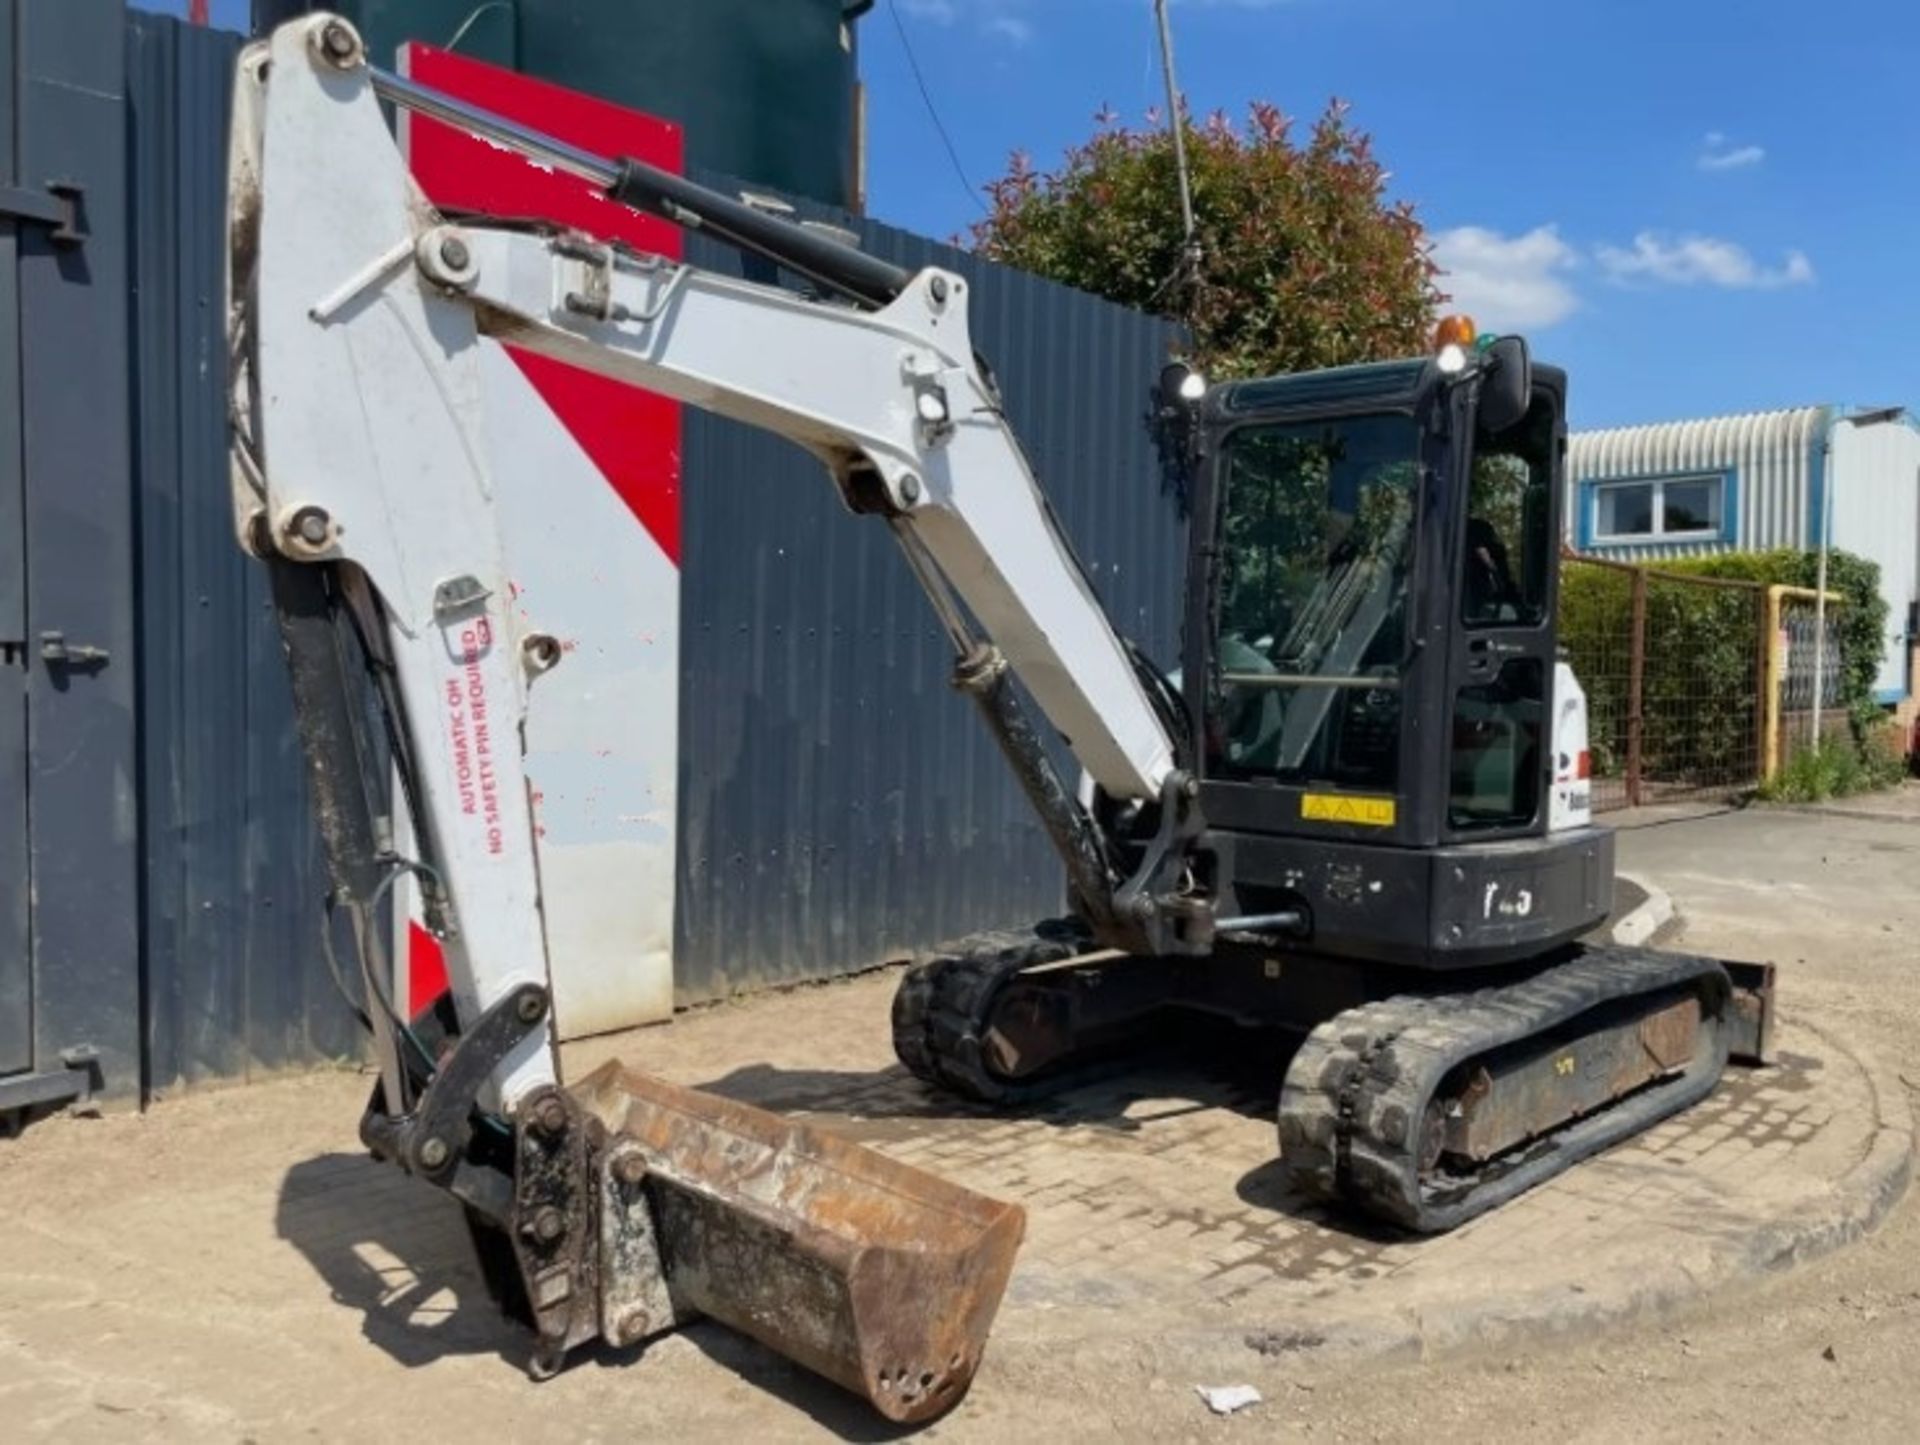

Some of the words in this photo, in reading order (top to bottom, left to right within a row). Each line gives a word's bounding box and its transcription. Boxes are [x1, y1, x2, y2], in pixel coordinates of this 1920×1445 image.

[447, 679, 463, 707] QH
[462, 630, 488, 721] REQUIRED
[450, 709, 476, 815] AUTOMATIC
[475, 722, 491, 756] PIN
[479, 760, 500, 825] SAFETY
[488, 828, 502, 854] NO
